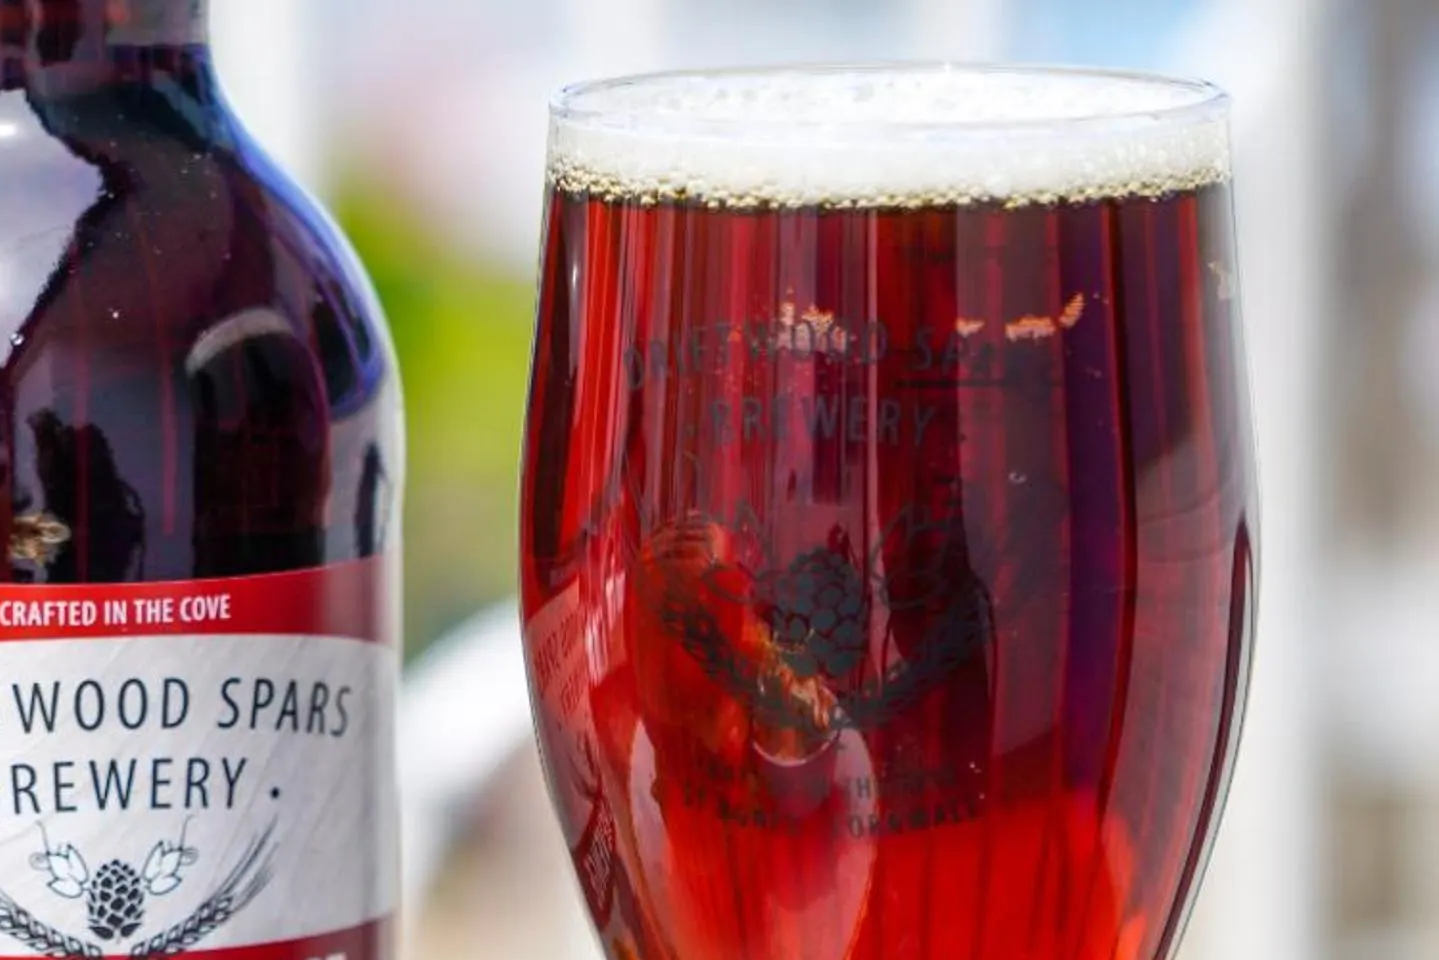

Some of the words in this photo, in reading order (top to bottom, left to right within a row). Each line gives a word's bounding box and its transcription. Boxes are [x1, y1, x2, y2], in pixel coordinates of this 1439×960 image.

[710, 396, 936, 448] BREWERY
[103, 599, 128, 625] IN
[133, 597, 174, 624] THE
[179, 593, 232, 622] COVE
[216, 676, 353, 739] SPARS
